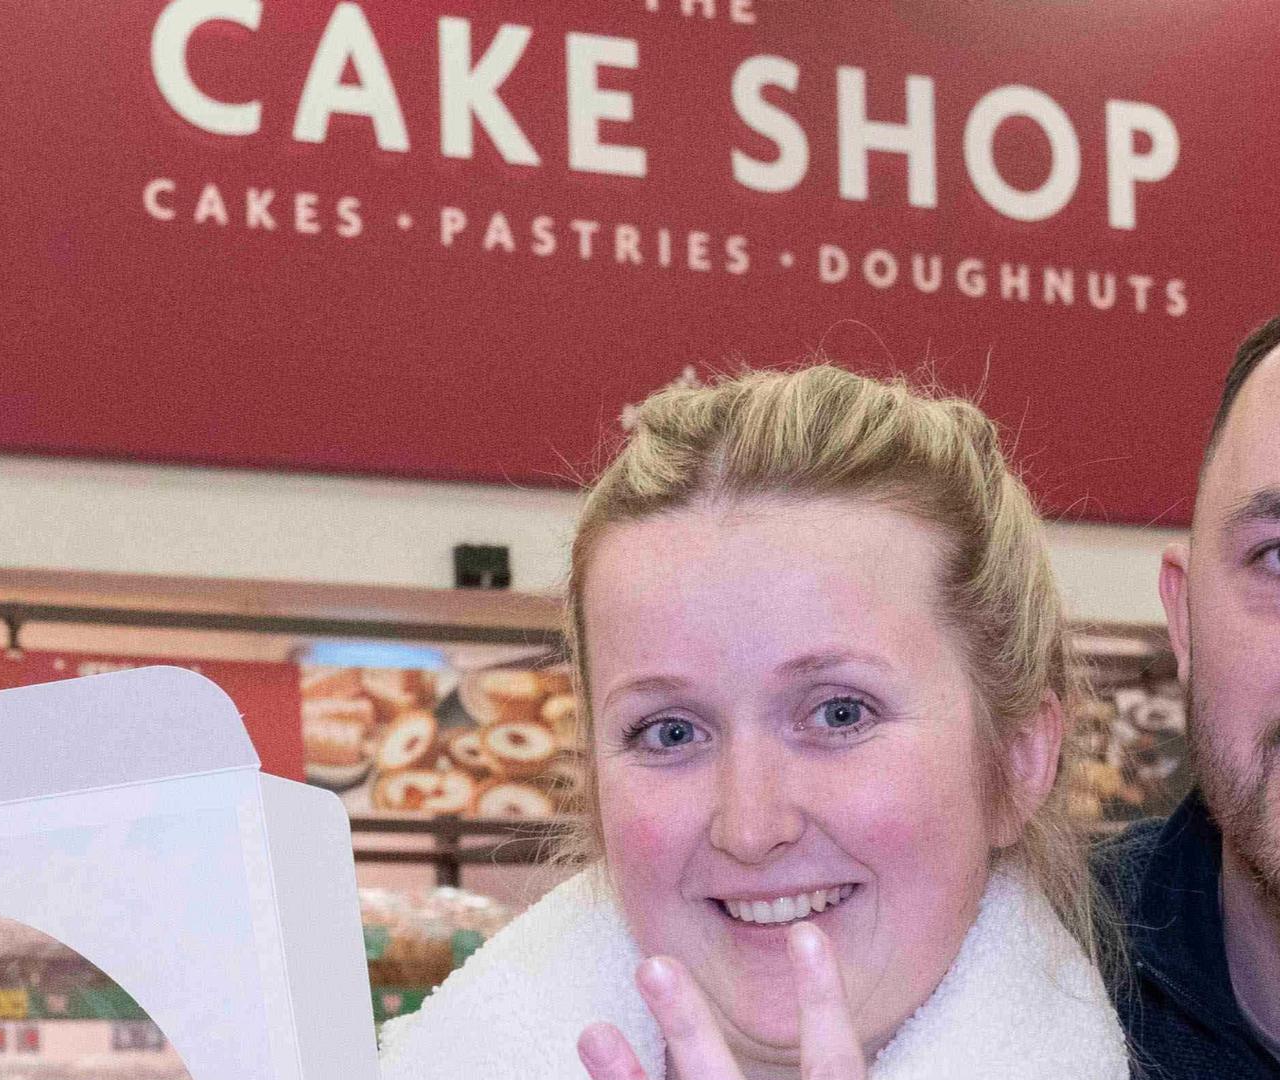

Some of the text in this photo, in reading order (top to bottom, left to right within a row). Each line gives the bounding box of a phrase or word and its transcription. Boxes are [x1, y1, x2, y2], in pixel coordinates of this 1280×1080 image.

[149, 0, 1181, 230] CAKE SHOP
[143, 178, 1189, 316] CAKES PASTRIES DOUGHNUTS
